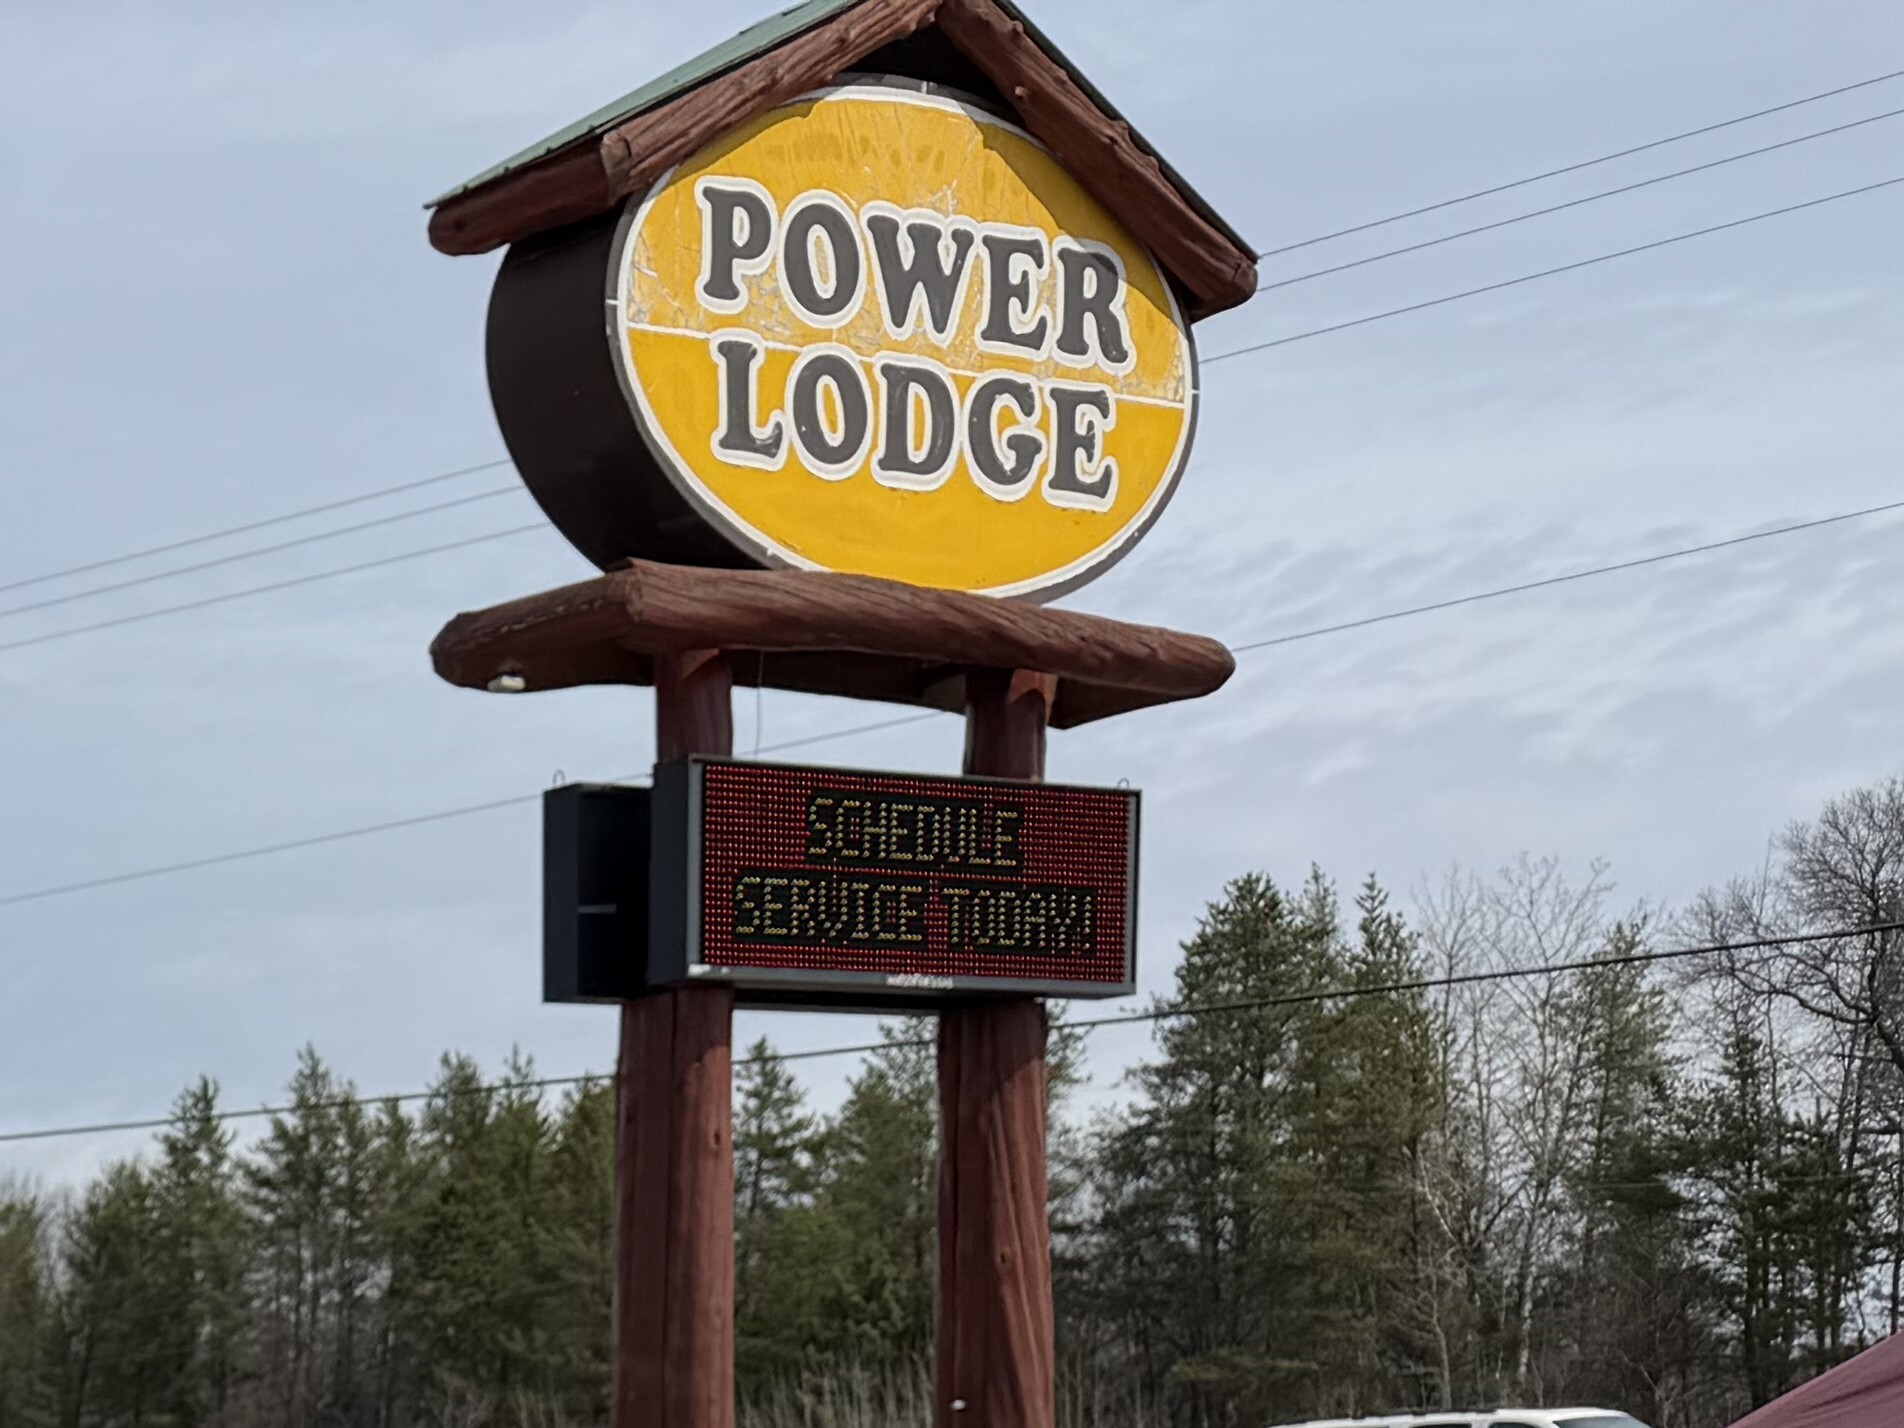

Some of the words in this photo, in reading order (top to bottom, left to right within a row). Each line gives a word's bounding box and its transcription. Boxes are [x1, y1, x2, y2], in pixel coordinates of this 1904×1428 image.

[700, 186, 1131, 364] POWER
[713, 338, 1114, 500] LODGE
[808, 797, 1018, 867] SCHEDULE
[735, 876, 923, 941] SERVICE
